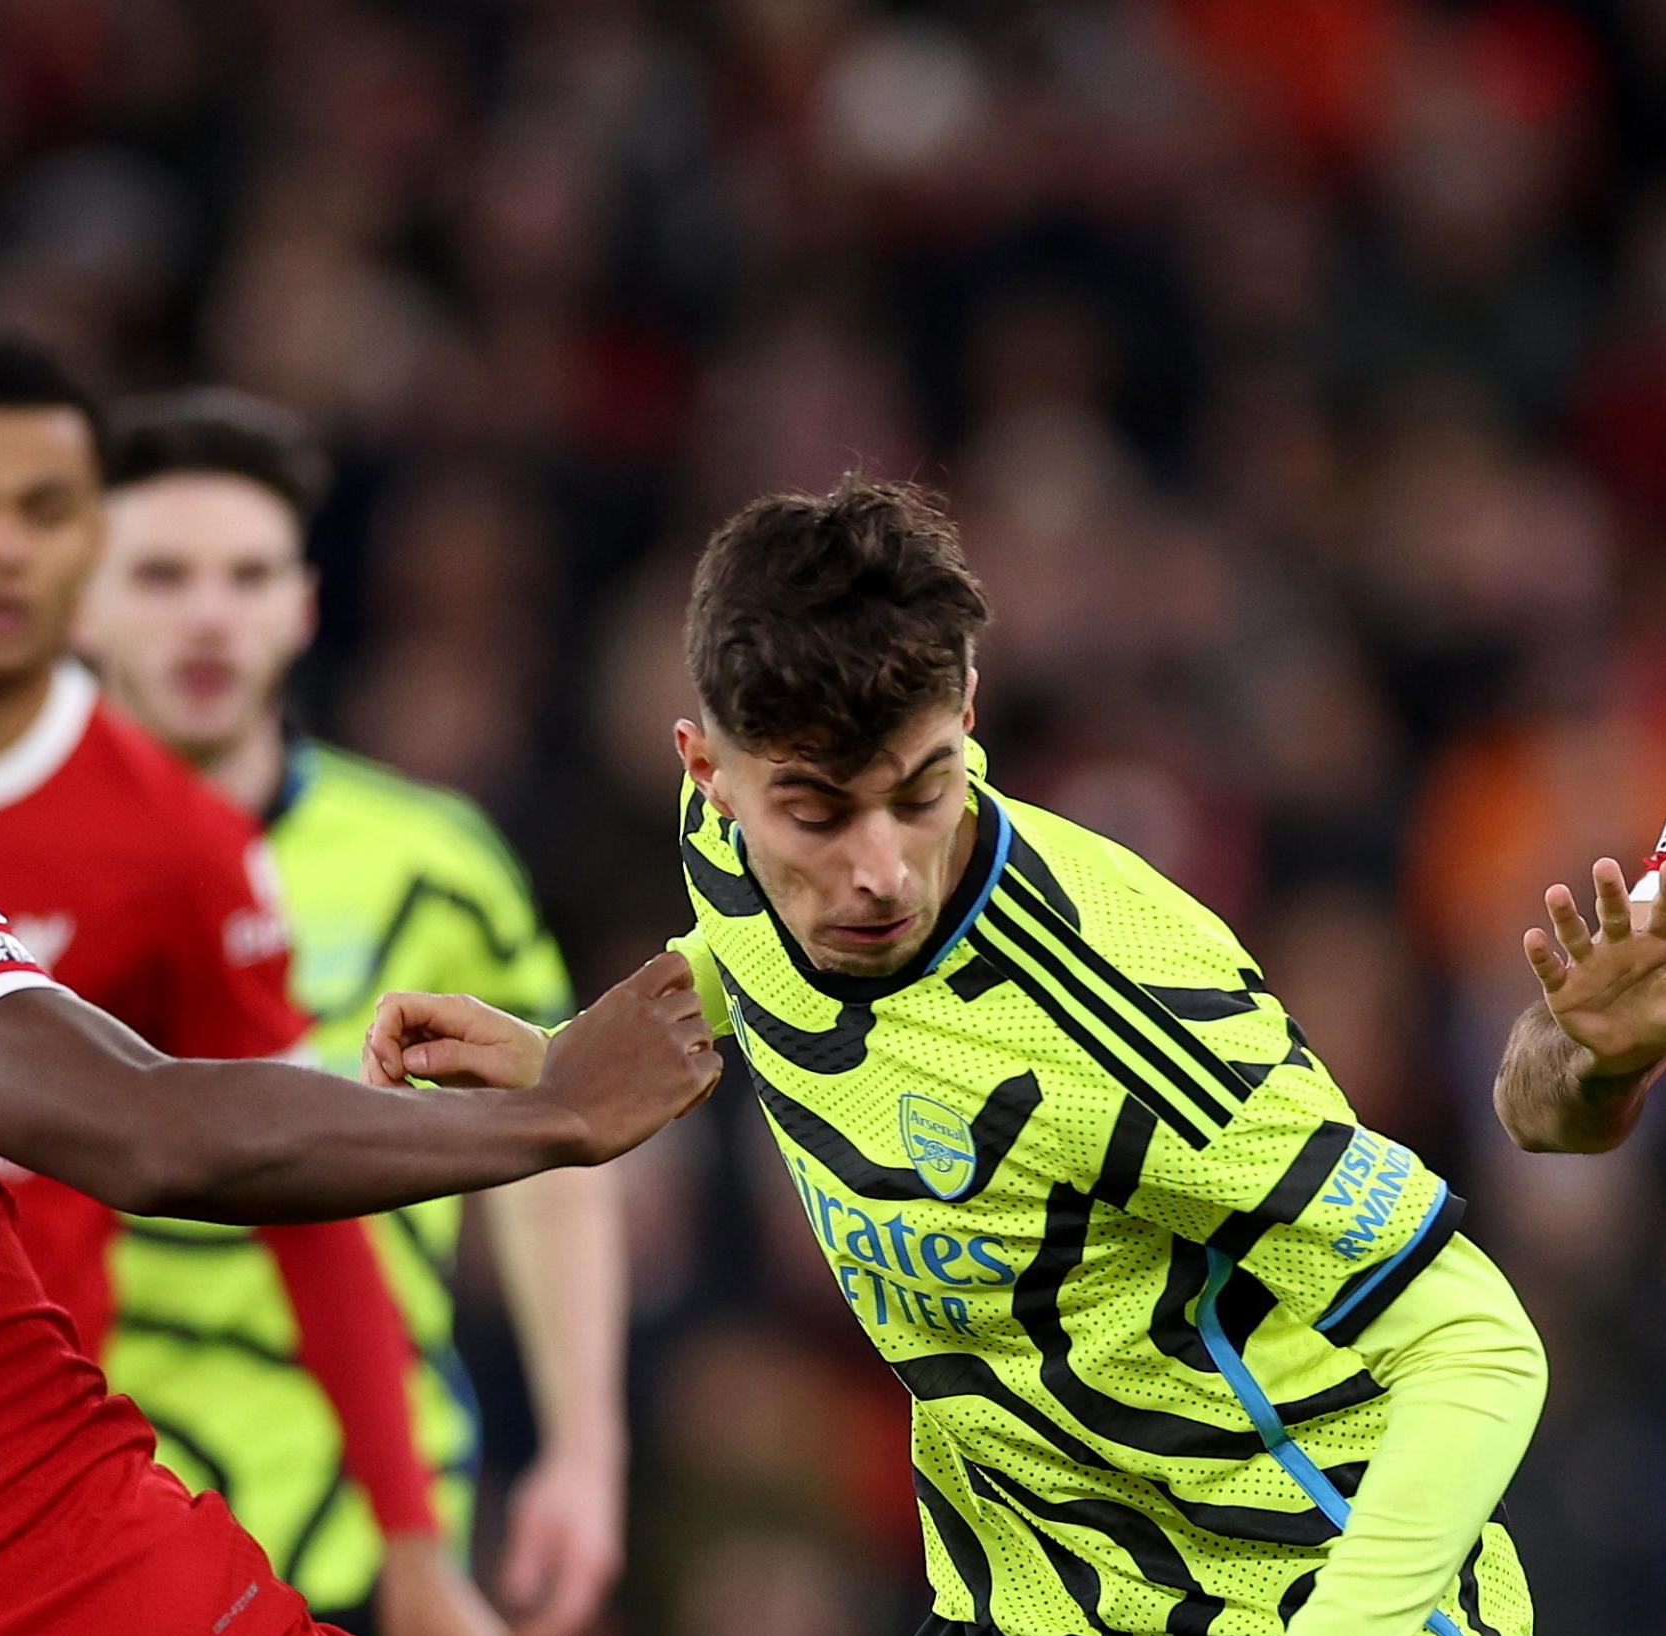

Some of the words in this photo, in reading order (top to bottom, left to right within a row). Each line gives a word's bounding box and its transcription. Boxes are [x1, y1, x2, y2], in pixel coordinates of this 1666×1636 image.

[908, 1110, 965, 1143] Arsenal
[1321, 1130, 1382, 1207] VISIT
[794, 1156, 1017, 1287] irates
[839, 1264, 979, 1338] ETTER
